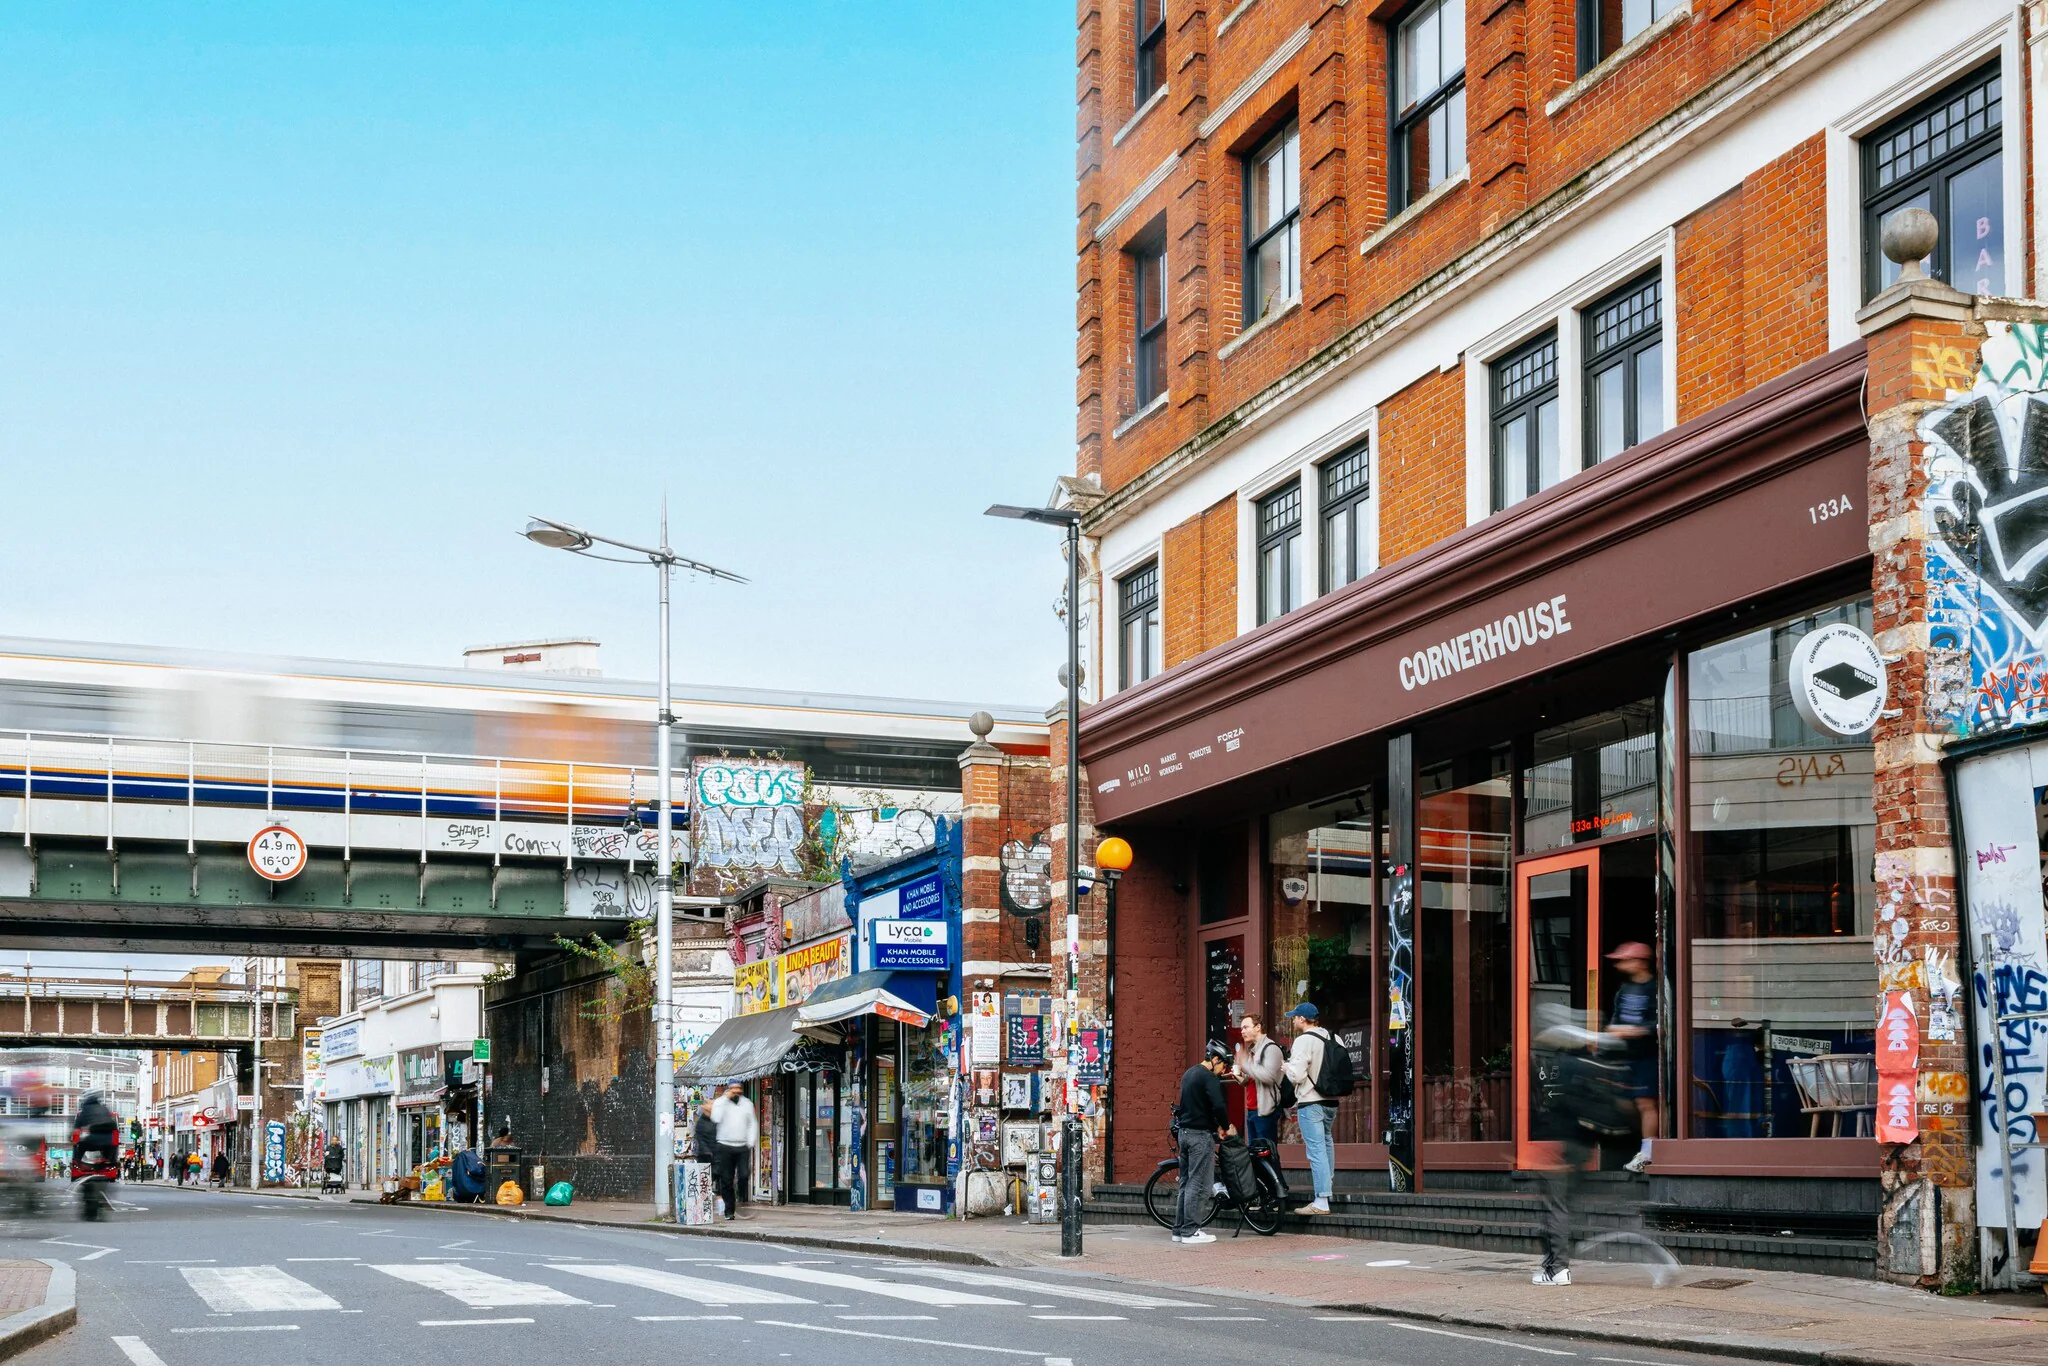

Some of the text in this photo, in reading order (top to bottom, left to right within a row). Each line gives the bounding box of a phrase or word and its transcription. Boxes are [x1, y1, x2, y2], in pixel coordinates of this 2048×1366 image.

[1809, 494, 1853, 524] 133A
[1400, 594, 1571, 690] CORNERHOUSE
[1808, 633, 1831, 664] COWORKING
[1866, 645, 1881, 669] EVENTS
[1813, 676, 1841, 696] CORNER
[1854, 668, 1877, 687] HOUSE
[1808, 689, 1882, 730] FOOD DRINKS MUSIC FITNESS
[1217, 728, 1244, 743] FORZA
[1160, 753, 1177, 765] MARKET
[1127, 764, 1150, 781] MILO
[1159, 763, 1183, 777] WORKSPACE
[1571, 811, 1633, 833] 133a Rye Lane
[259, 839, 283, 850] 4.9
[906, 881, 936, 900] KHAN MOBILE
[902, 903, 913, 914] AND
[912, 892, 940, 910] ACCESSORIES
[888, 924, 922, 938] Lyca
[786, 940, 839, 973] LINDA BEAUTY
